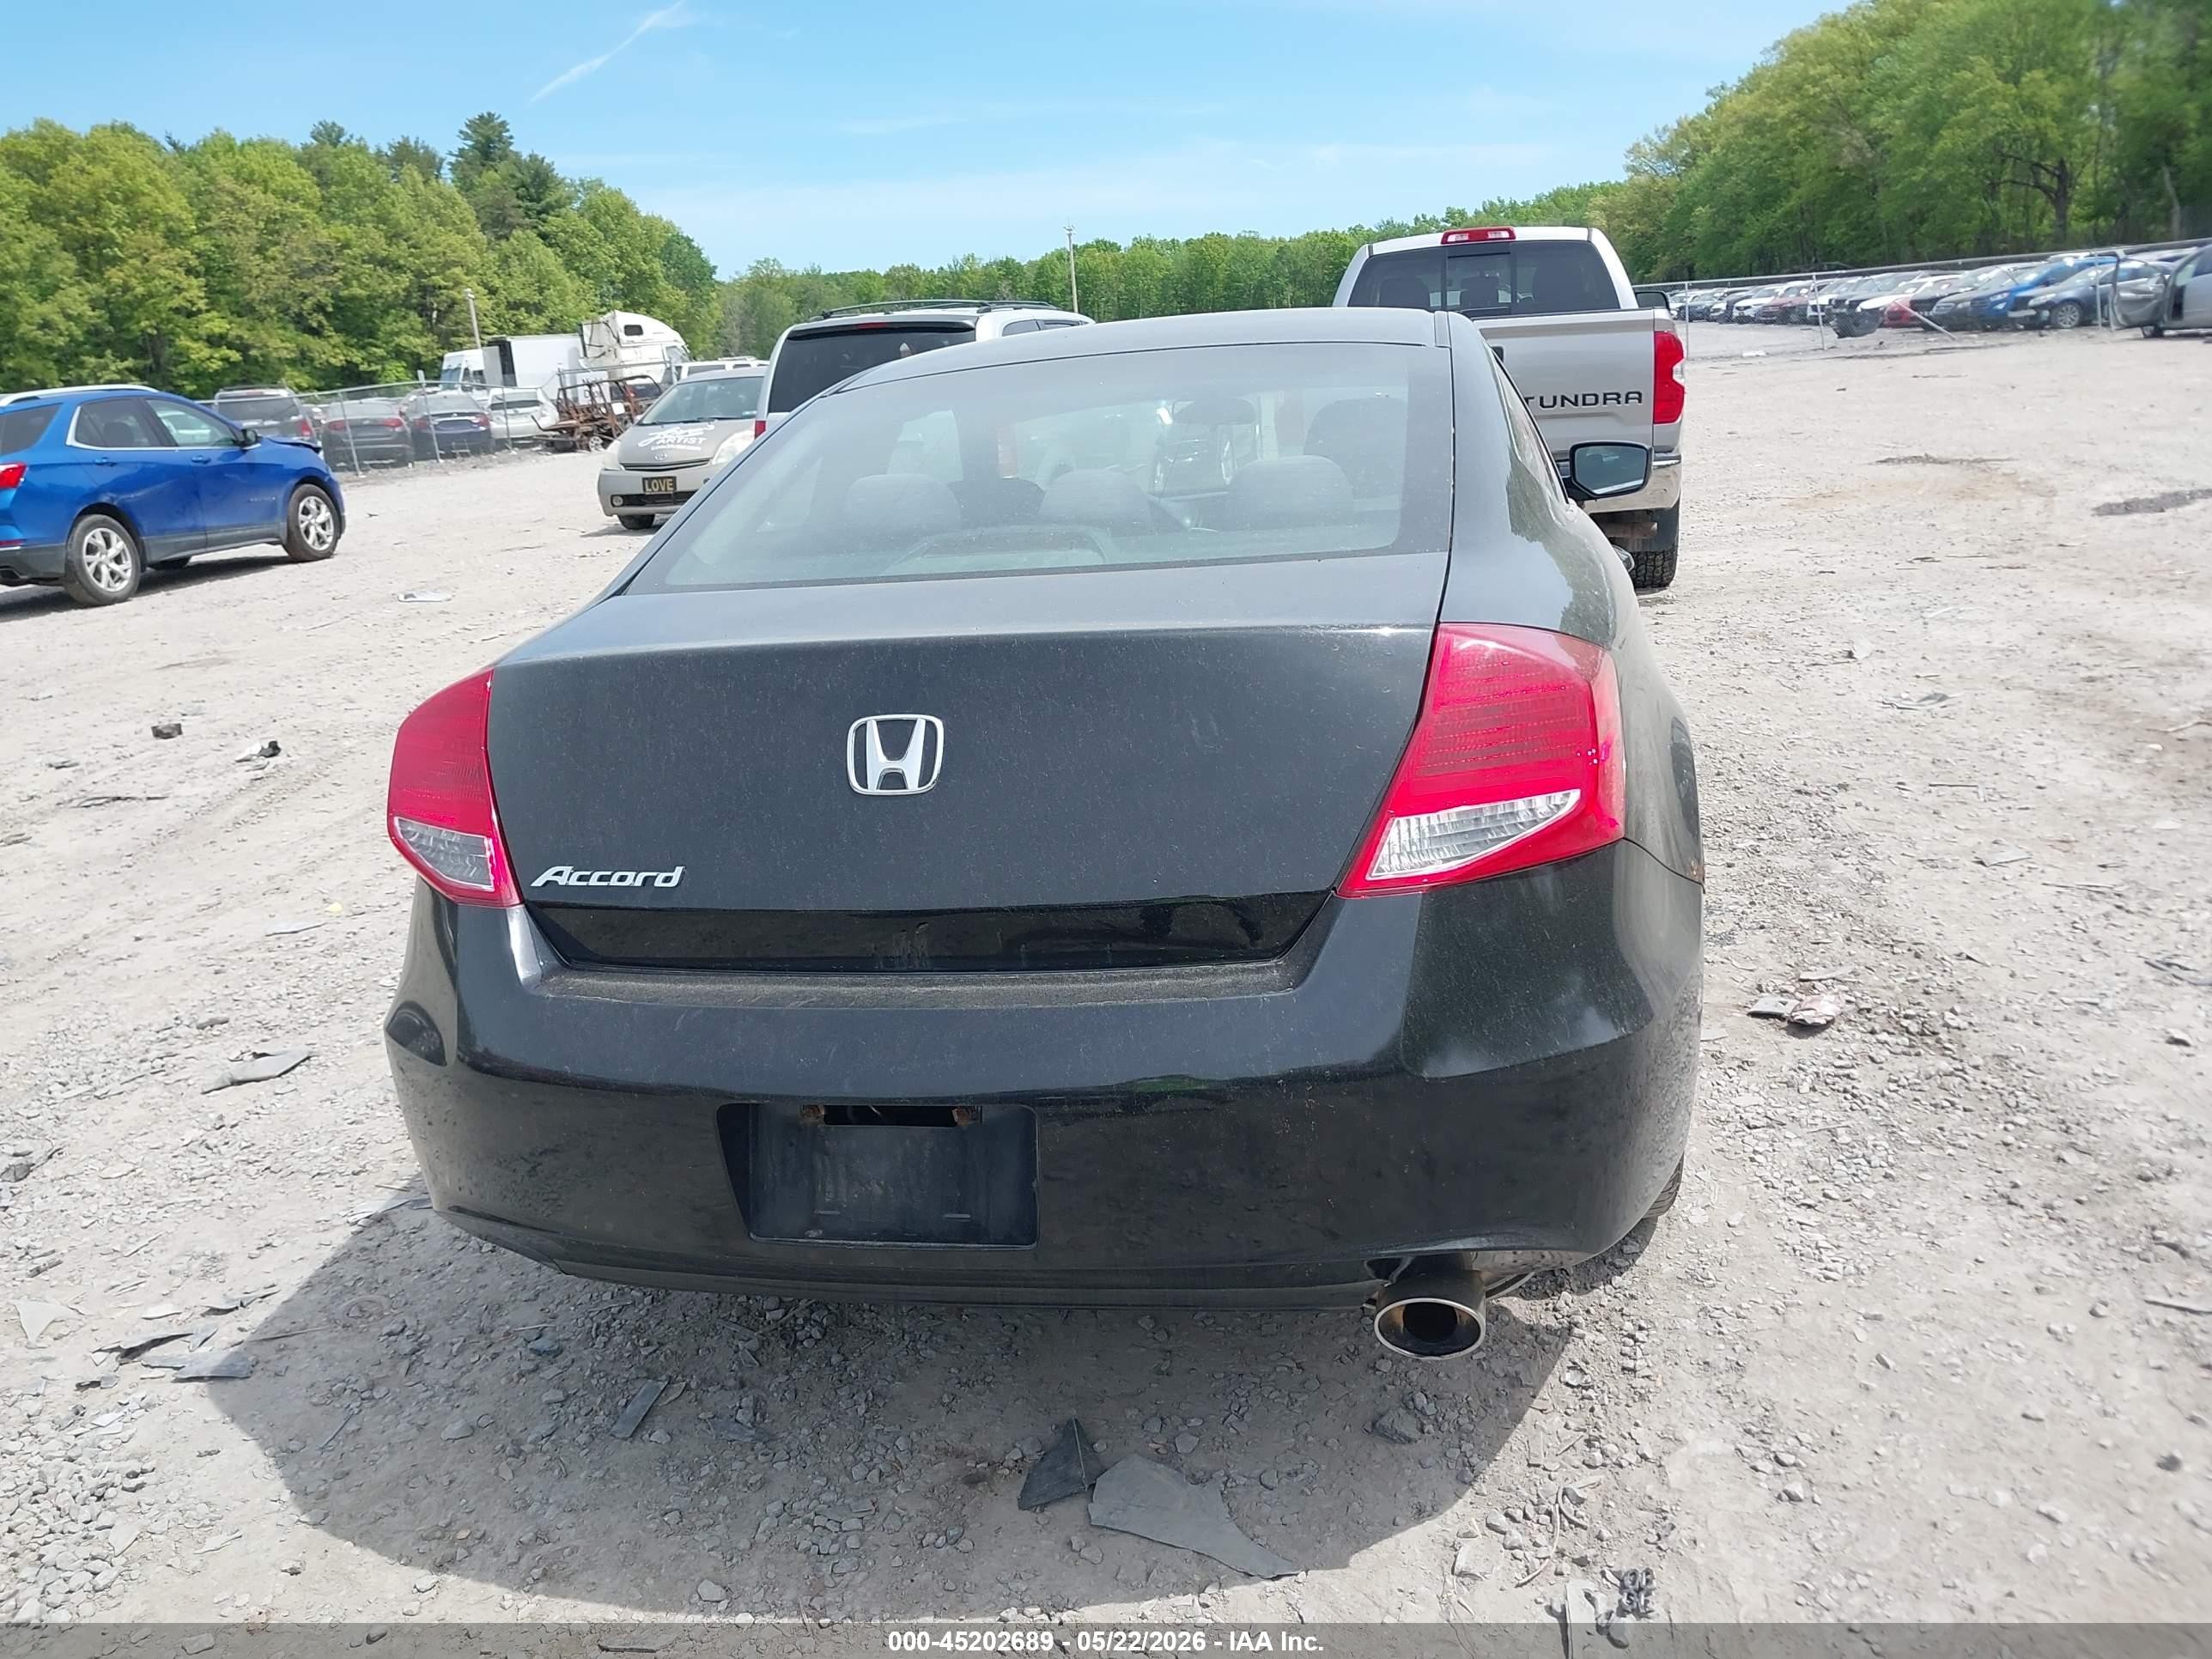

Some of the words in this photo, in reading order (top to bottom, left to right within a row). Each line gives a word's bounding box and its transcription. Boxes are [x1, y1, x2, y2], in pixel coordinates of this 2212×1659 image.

[1523, 391, 1643, 409] TUNDRA
[655, 436, 708, 445] ARTIST
[645, 478, 673, 492] LOVE
[531, 866, 686, 888] Accord
